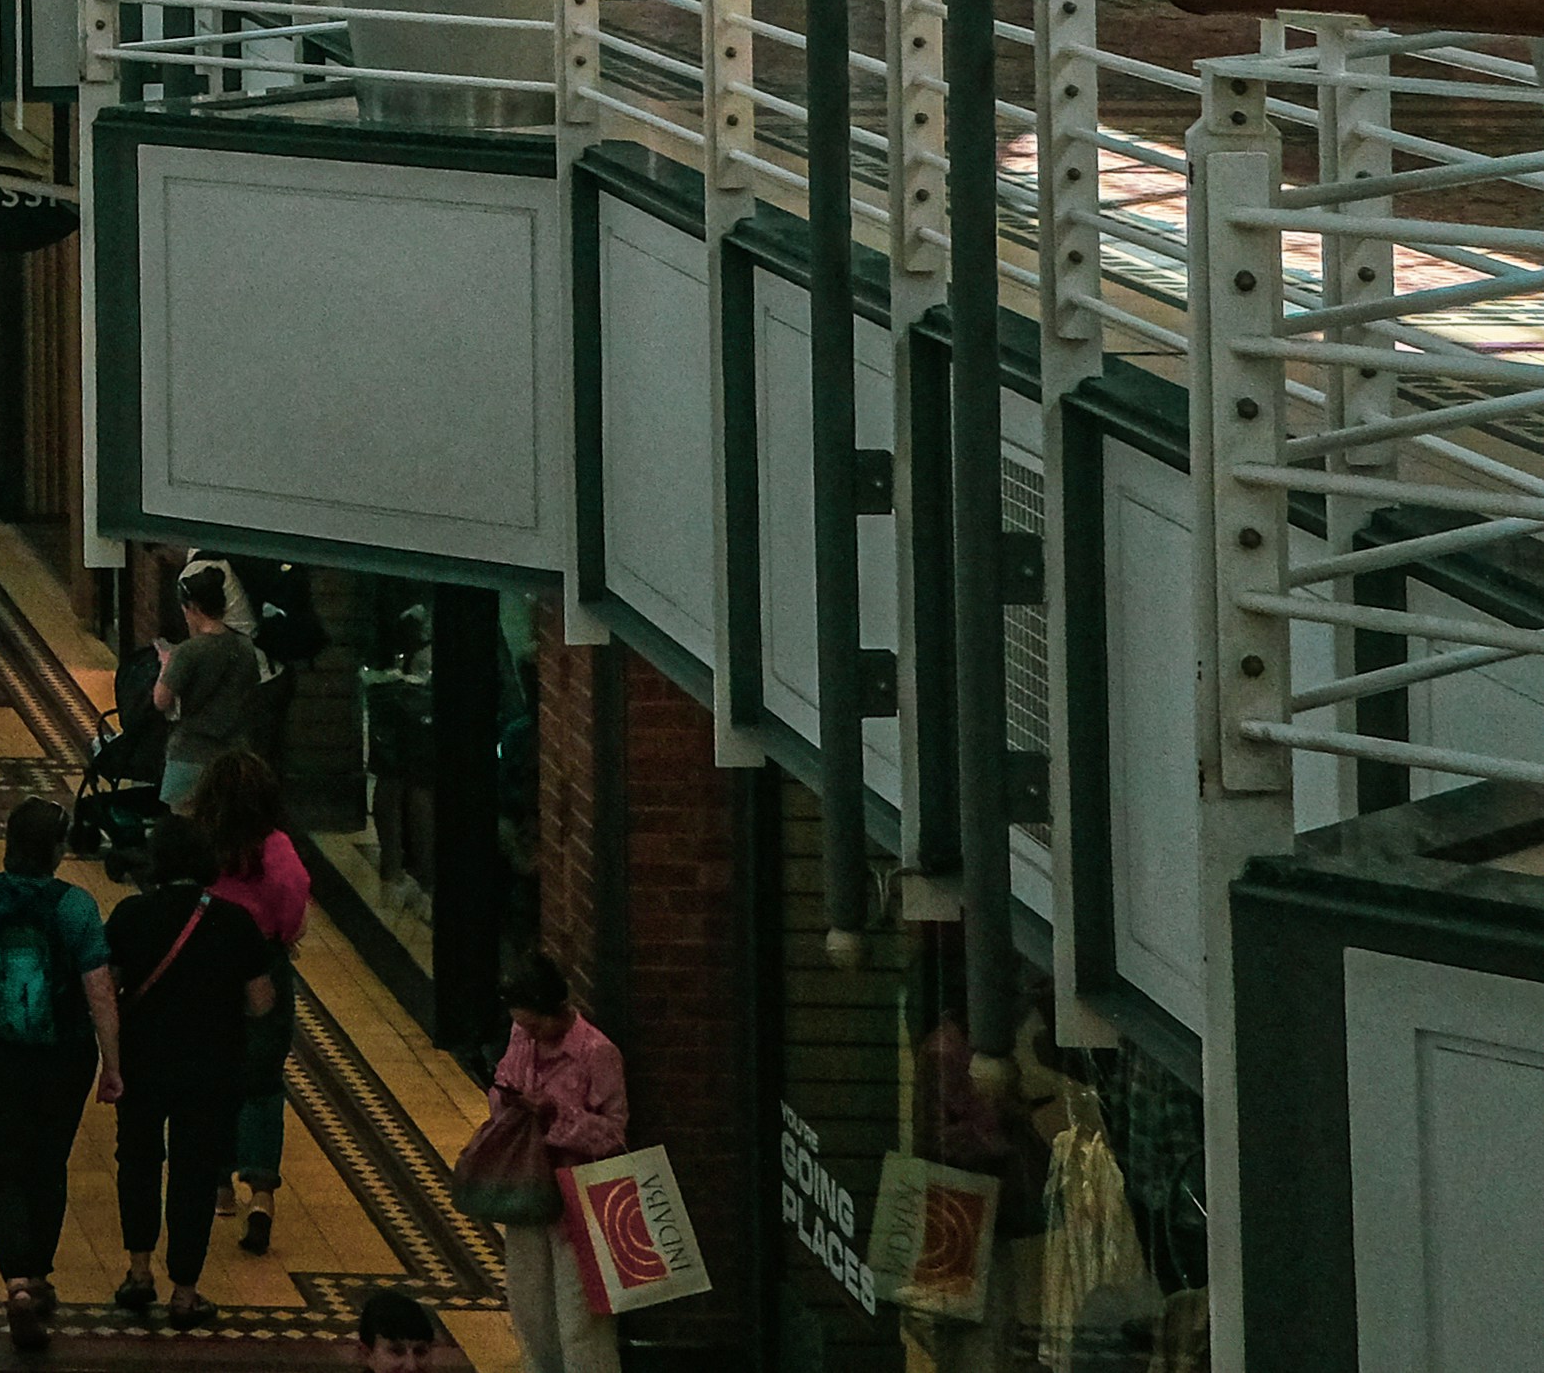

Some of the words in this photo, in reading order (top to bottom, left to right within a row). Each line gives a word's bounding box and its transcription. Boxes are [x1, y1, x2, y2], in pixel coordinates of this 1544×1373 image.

[640, 1173, 692, 1273] INDABA
[781, 1131, 855, 1239] GOING
[782, 1181, 876, 1317] PLACES
